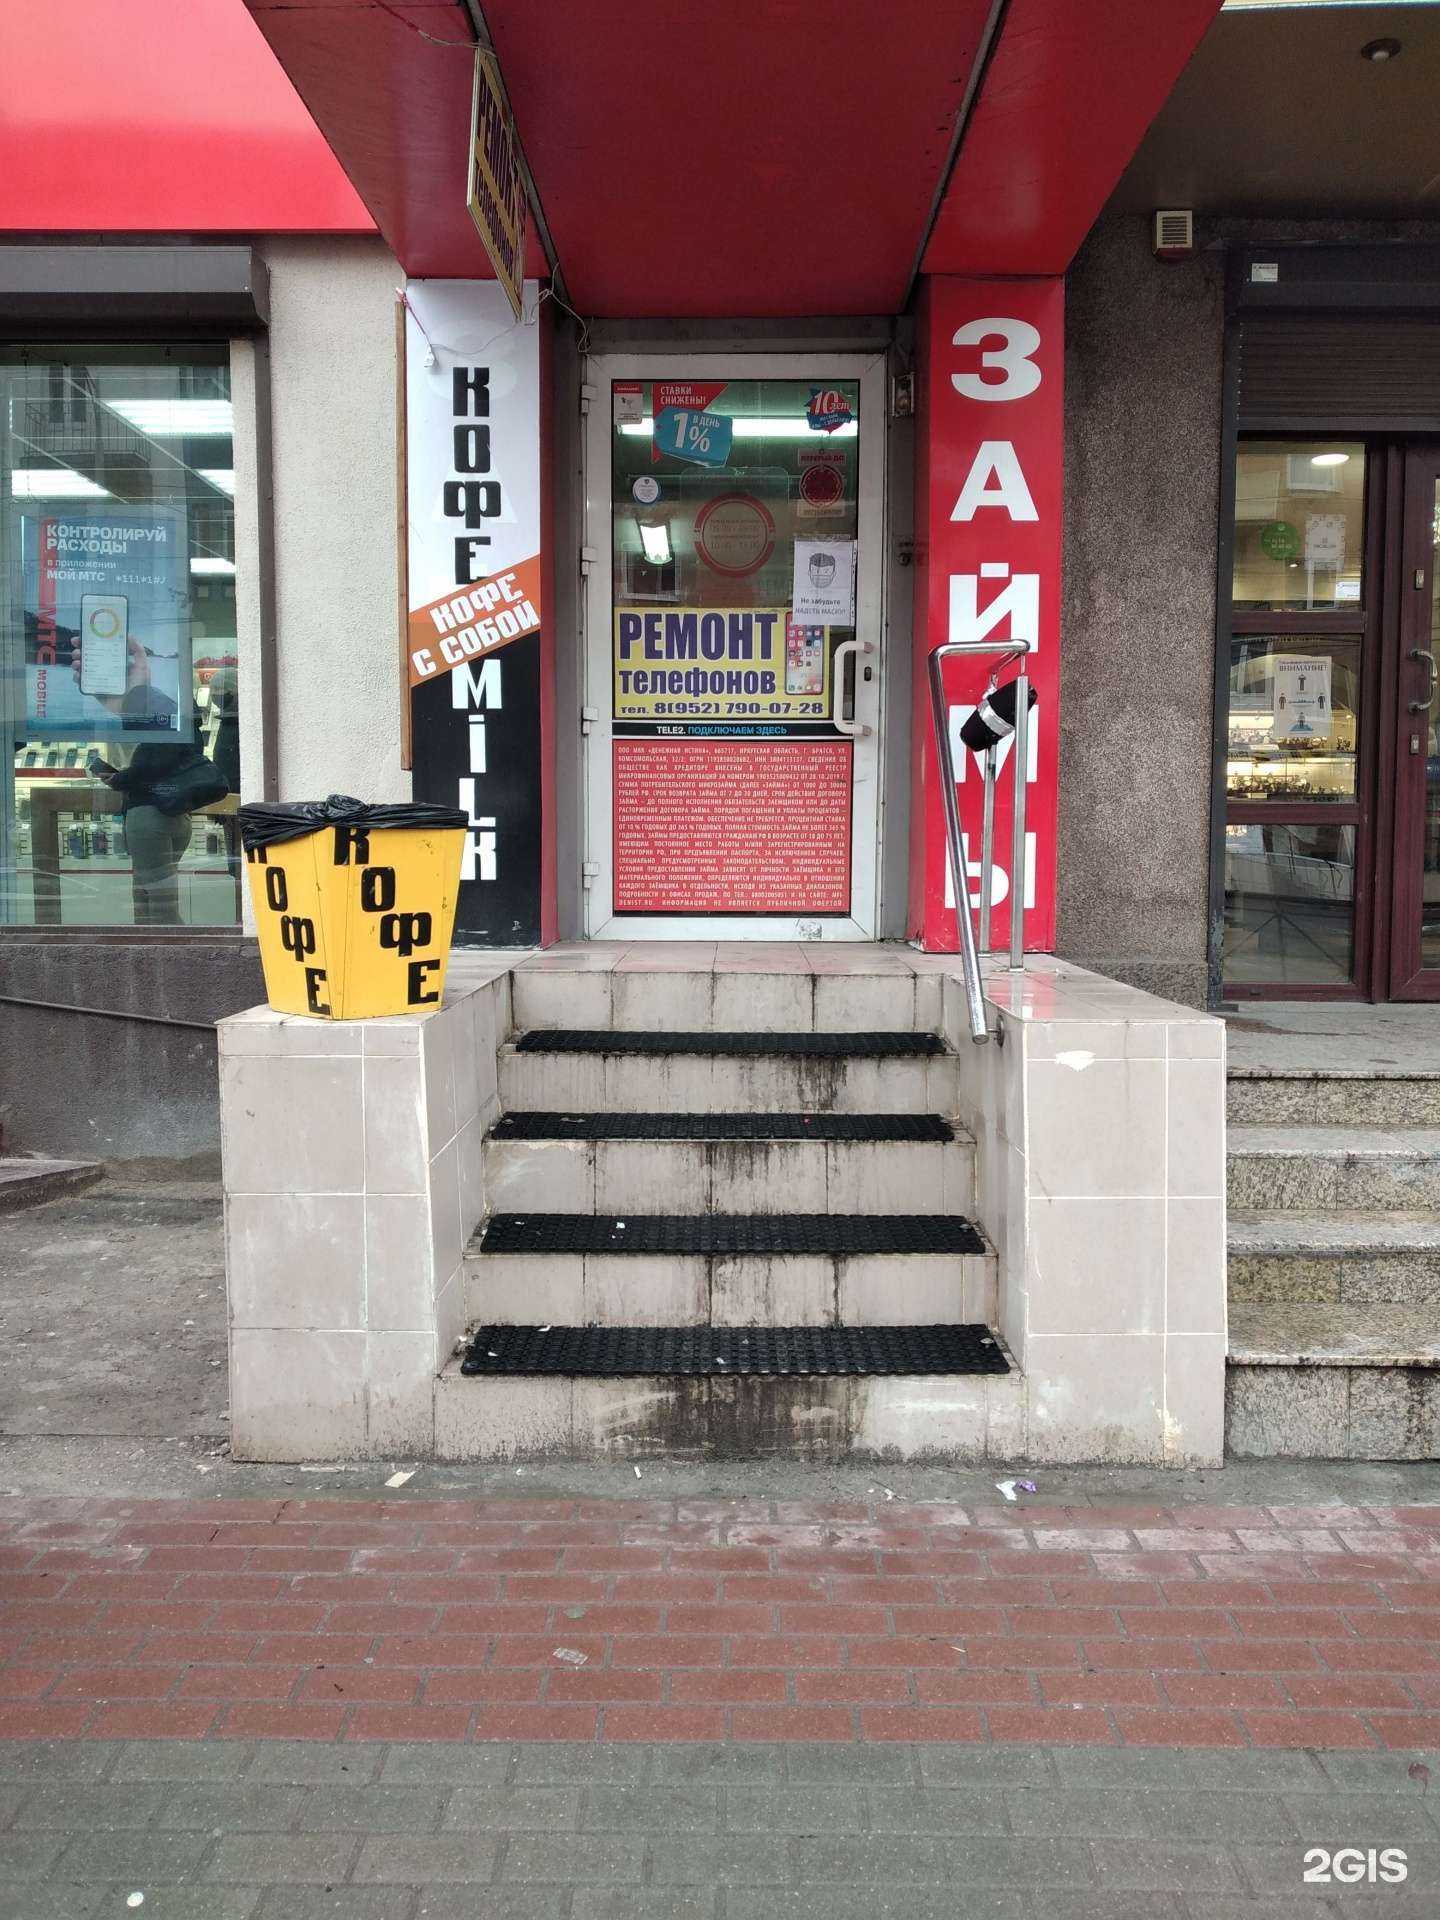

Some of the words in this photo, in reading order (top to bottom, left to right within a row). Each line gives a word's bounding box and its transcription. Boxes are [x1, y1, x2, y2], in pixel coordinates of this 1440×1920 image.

[660, 386, 692, 395] СТАВКИ
[660, 396, 706, 405] СНИЖЕНЫ!
[814, 391, 838, 415] 10
[699, 416, 720, 428] ДЕНЬ
[47, 524, 167, 543] КОНТРОЛИРУЙ
[47, 538, 127, 554] РАСХОДЫ
[55, 560, 117, 570] приложении
[47, 568, 76, 580] МОЙ
[78, 570, 106, 582] МТС
[944, 317, 1041, 909] ЗАЙМЫ
[36, 608, 57, 665] МТС
[439, 600, 541, 664] СОБОЙ
[619, 613, 778, 660] РЕМОНТ
[619, 667, 776, 698] телефонов
[621, 706, 648, 714] тел.
[654, 702, 720, 714] 8(952)
[726, 702, 824, 714] 790-07-28
[656, 726, 686, 735] TELE2.
[688, 726, 754, 736] ПОДКЛЮЧАЕМ
[755, 726, 787, 736] ЗДЕСЬ
